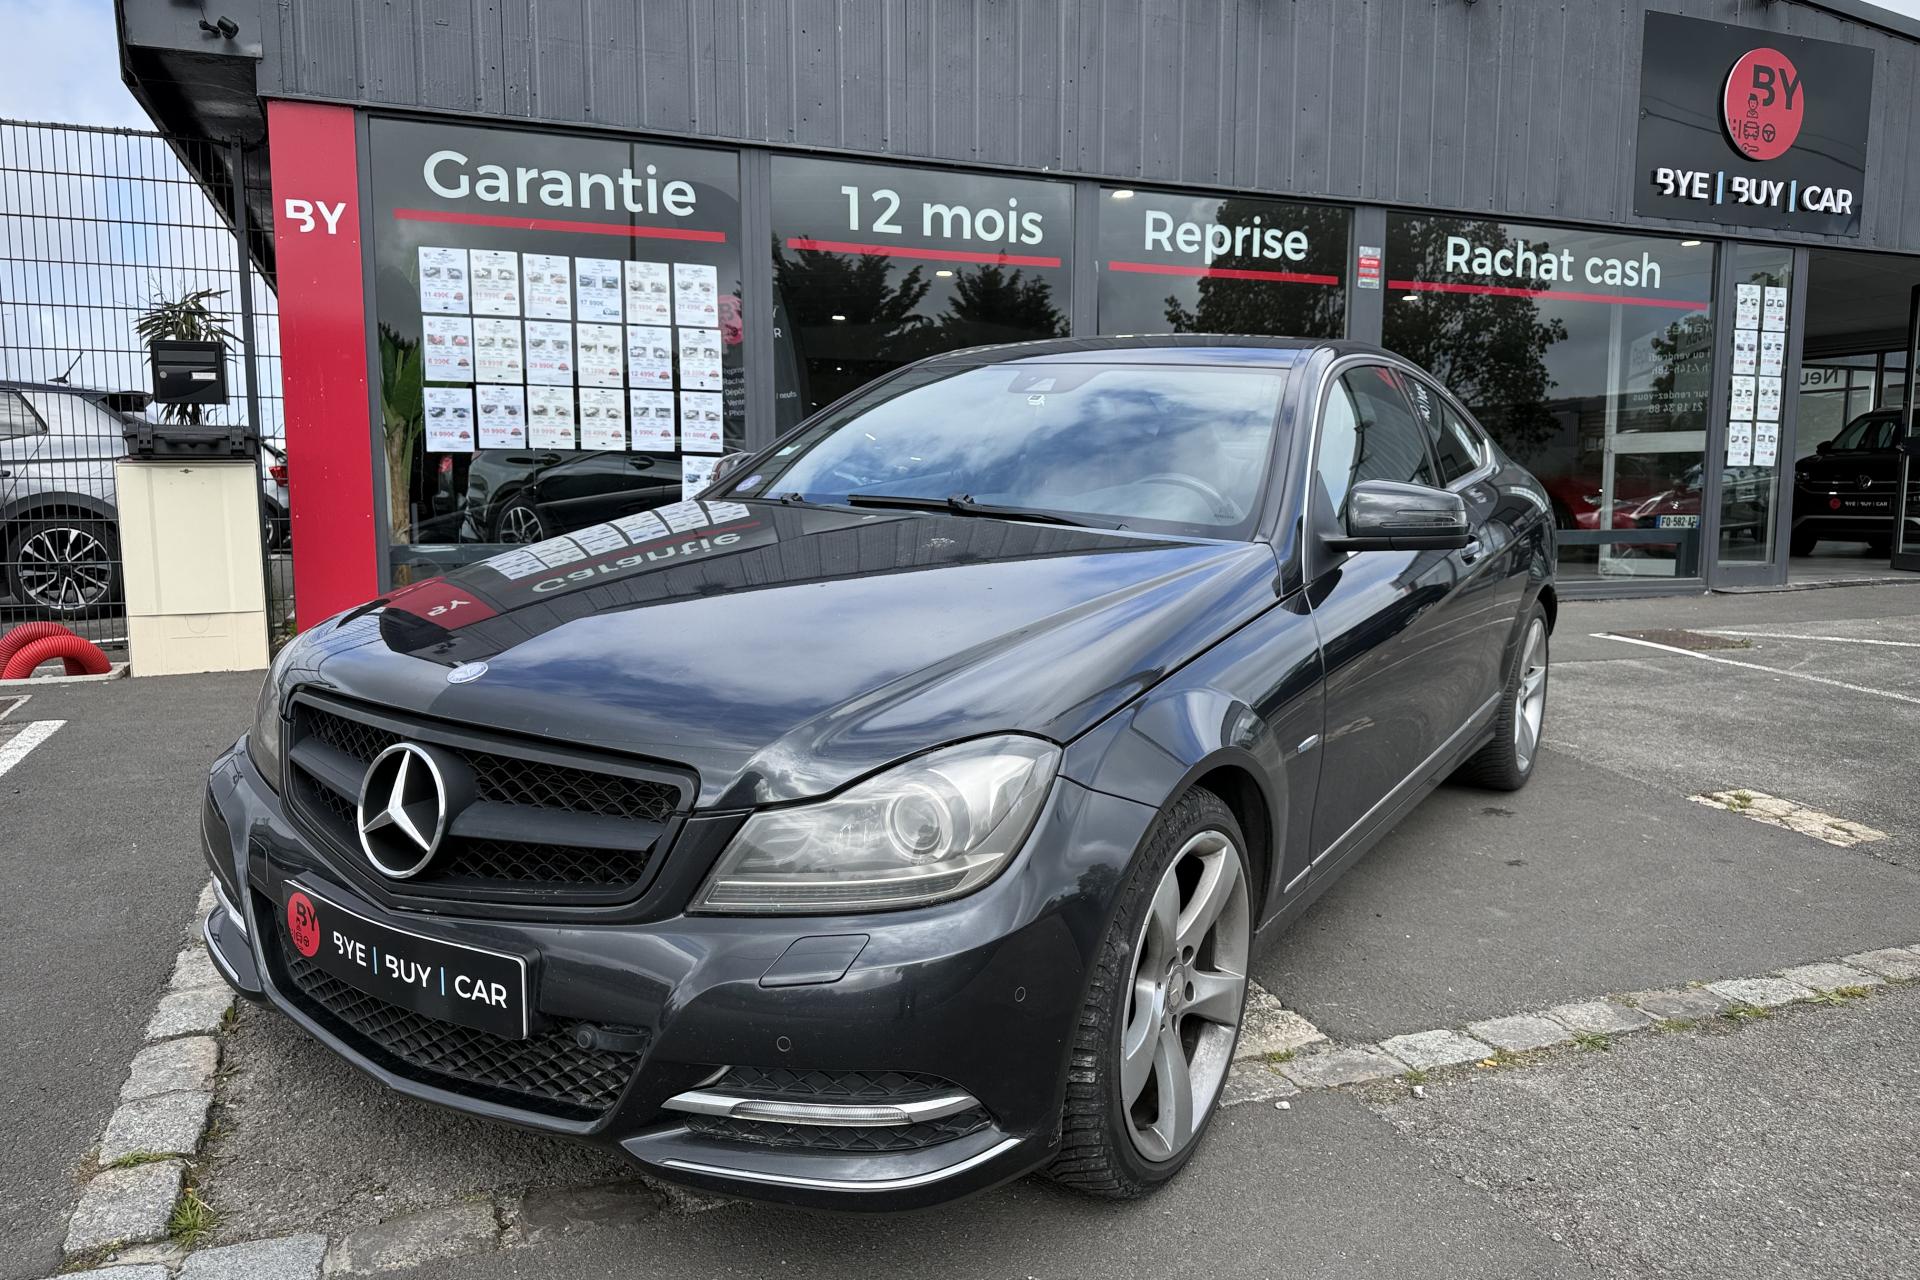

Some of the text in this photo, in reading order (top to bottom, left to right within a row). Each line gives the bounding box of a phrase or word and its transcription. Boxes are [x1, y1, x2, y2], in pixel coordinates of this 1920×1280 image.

[1752, 64, 1800, 110] BY
[423, 150, 697, 217] Garantie
[1656, 167, 1853, 215] BYE BUY CAR
[285, 199, 347, 235] BY
[841, 185, 1044, 245] 12 mois
[1144, 210, 1310, 264] Reprise
[1445, 236, 1661, 289] Rachat cash
[295, 901, 317, 932] BY
[332, 930, 508, 1009] BYE BUY CAR
